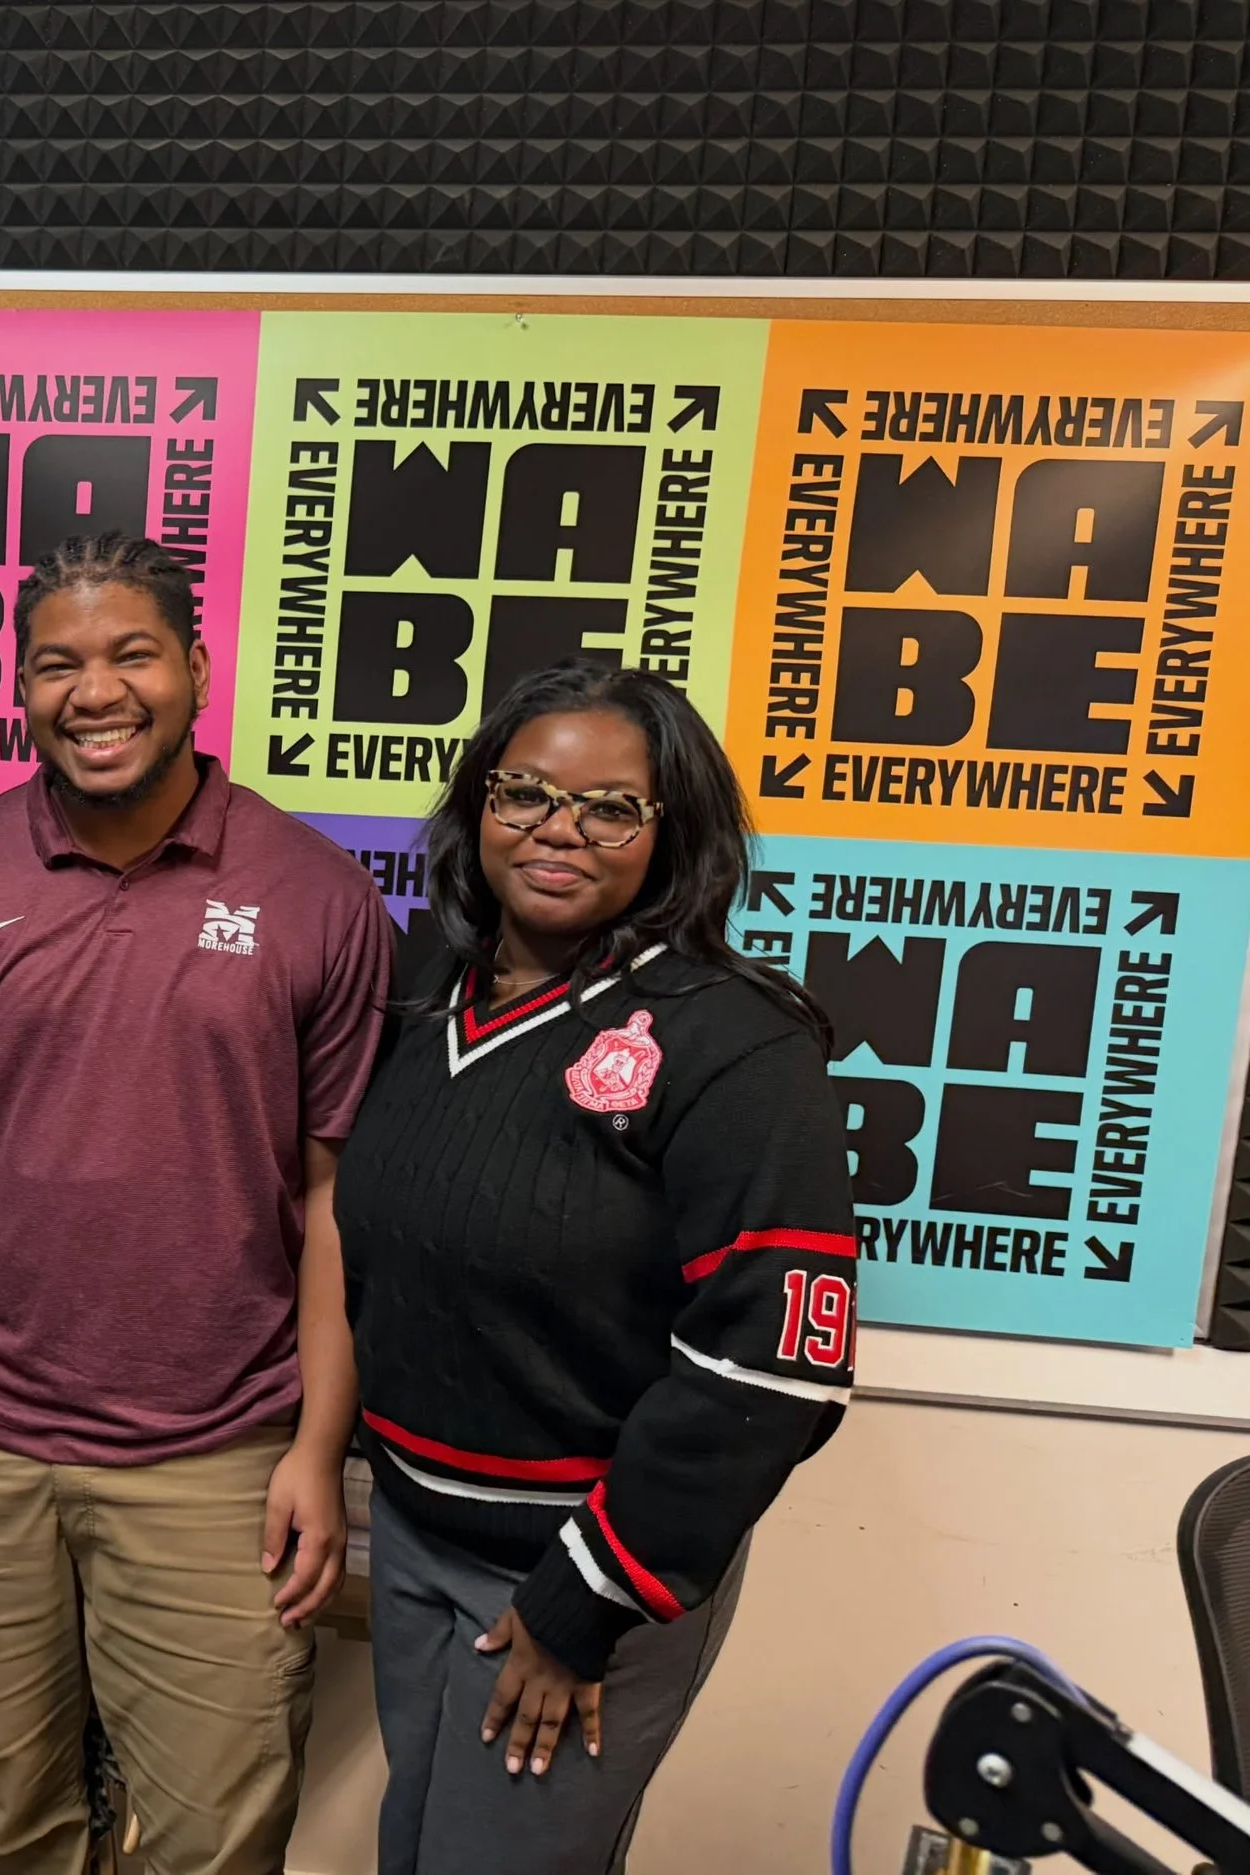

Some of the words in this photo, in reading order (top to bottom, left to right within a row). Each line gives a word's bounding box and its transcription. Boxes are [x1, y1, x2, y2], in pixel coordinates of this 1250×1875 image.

[353, 378, 656, 433] EVERYWHERE
[861, 390, 1175, 449] EVERYWHERE
[271, 441, 339, 721] EVERYWHERE
[344, 439, 647, 584] WA
[639, 448, 714, 700] ERYWHERE
[844, 452, 1166, 602] WA
[765, 453, 845, 740] EVERYWHERE
[1145, 463, 1236, 757] EVERYWHERE
[830, 606, 1146, 755] BE
[326, 733, 472, 782] EVERY
[821, 753, 1128, 815] EVERYWHERE
[808, 873, 1112, 934] EVERYWHERE
[802, 930, 1103, 1078] WA
[828, 1075, 1084, 1221] BE
[1086, 950, 1173, 1226] EVERYWHERE
[776, 1269, 851, 1368] 19
[855, 1216, 1069, 1277] RYWHERE
